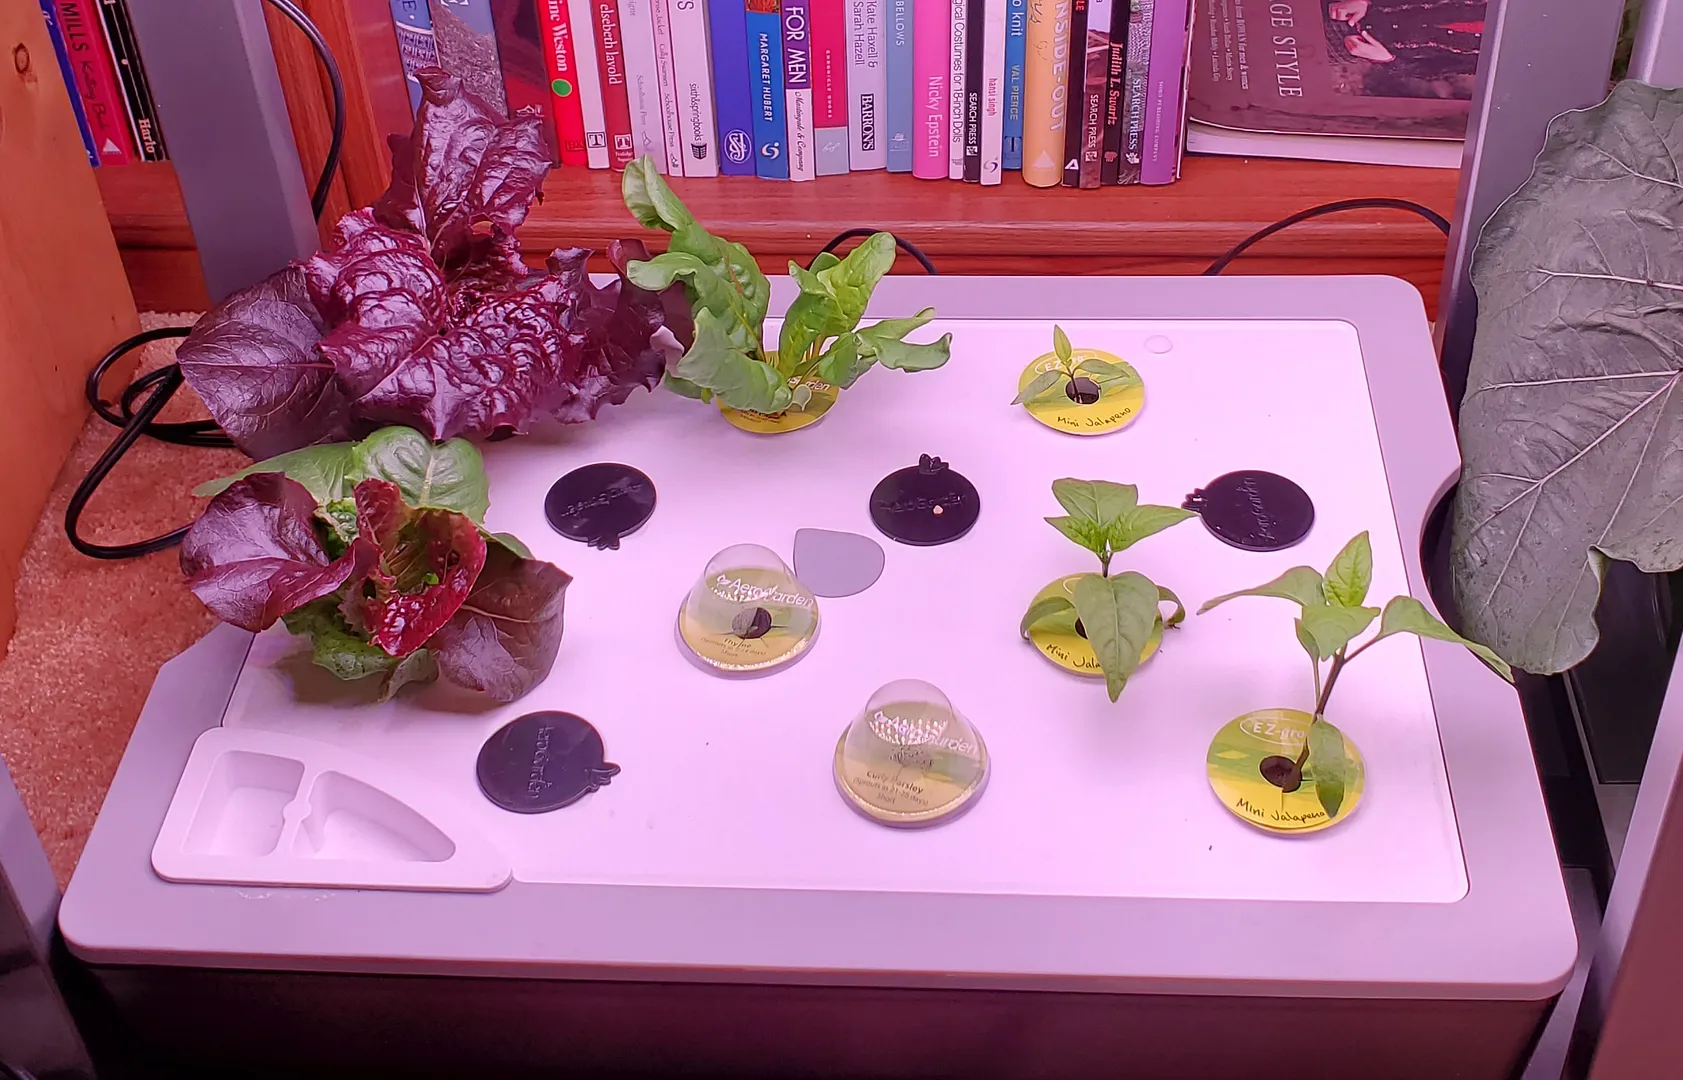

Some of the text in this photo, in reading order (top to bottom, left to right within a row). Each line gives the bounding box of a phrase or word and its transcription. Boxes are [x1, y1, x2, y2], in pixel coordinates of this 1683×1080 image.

[60, 2, 88, 52] MILLS
[552, 22, 569, 72] Weston
[600, 4, 623, 85] elsebeth lavold
[785, 6, 807, 83] FOR MEN
[853, 1, 865, 66] Sarah Hazell
[866, 1, 878, 68] Kate Haxell &
[895, 0, 905, 46] BELLOWS
[953, 23, 965, 71] Costumes
[1011, 12, 1025, 36] knit
[1110, 42, 1124, 76] Judith
[1268, 0, 1303, 97] GE STYLE
[759, 33, 773, 121] MARGARET HUBERT
[953, 73, 964, 85] for
[1009, 65, 1020, 120] VAL PIERCE
[862, 94, 874, 150] BARRON'S
[925, 76, 944, 157] Nicky Epstein
[953, 87, 964, 120] 18-inch
[968, 92, 978, 144] SEARCH PRESS
[1088, 94, 1099, 148] SEARCH PRESS
[1107, 90, 1120, 126] Swartz
[1128, 79, 1142, 150] SEARCH PRESS
[952, 121, 963, 143] Dolls
[1057, 407, 1132, 428] Mini Jalapeno
[1046, 643, 1101, 669] Mini Jala
[1236, 797, 1326, 824] Mini Jalapeno
